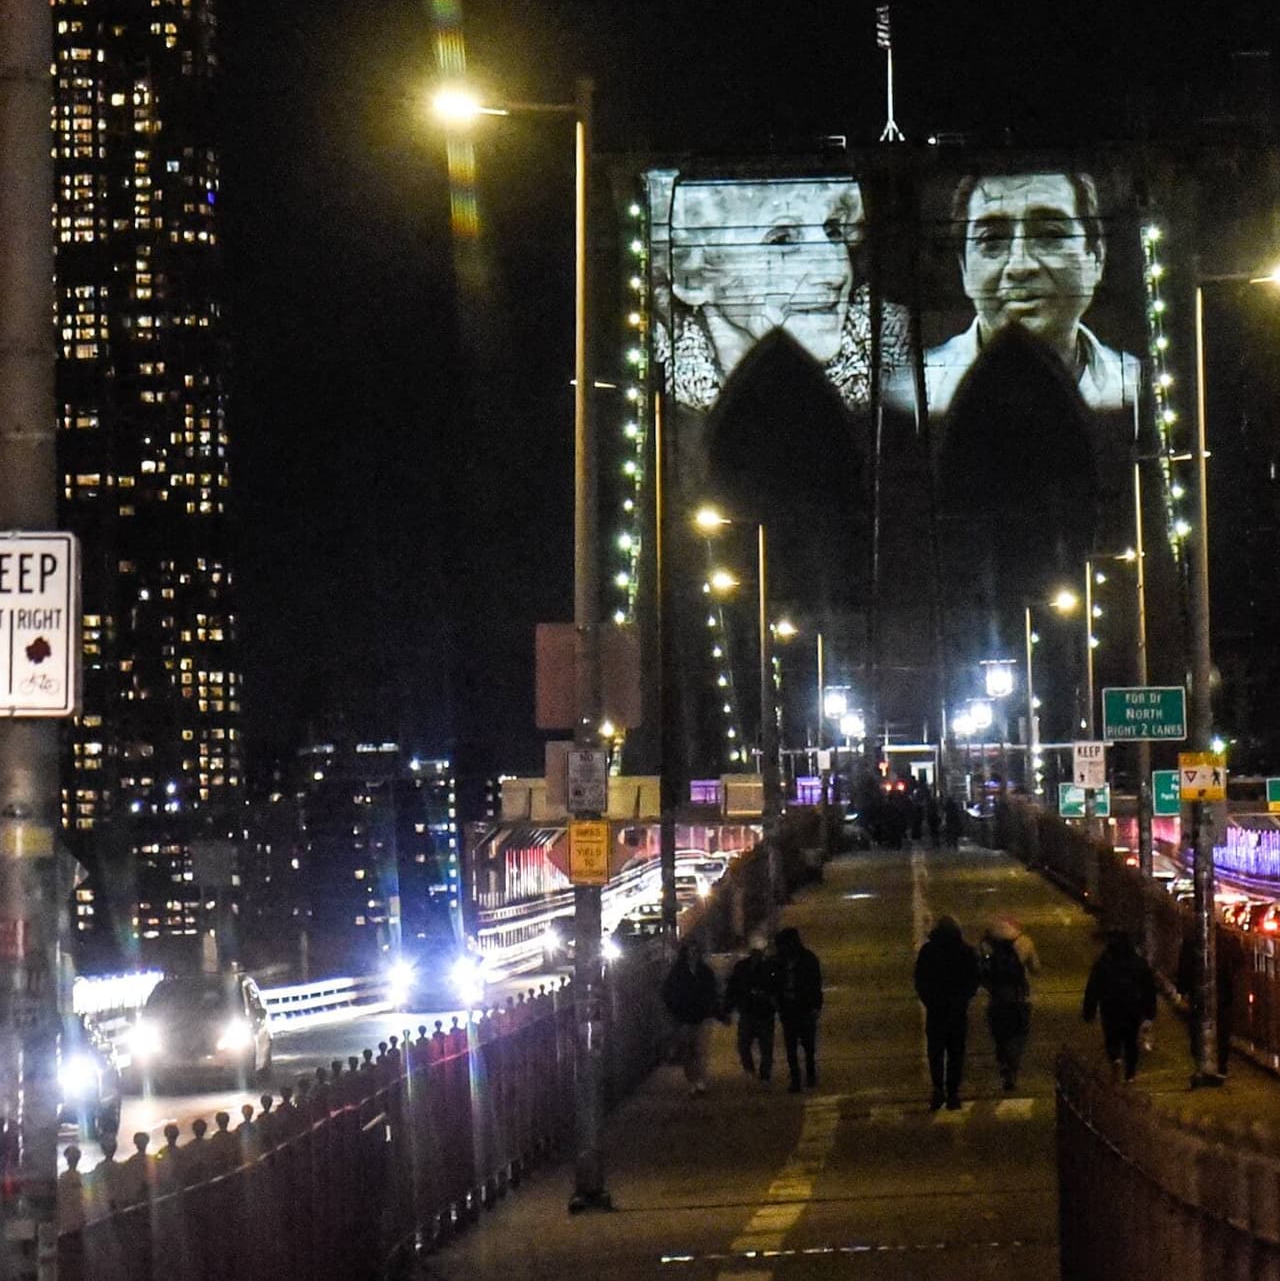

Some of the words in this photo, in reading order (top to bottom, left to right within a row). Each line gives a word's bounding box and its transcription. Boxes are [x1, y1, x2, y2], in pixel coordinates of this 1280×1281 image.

[17, 609, 62, 629] RIGHT
[1107, 725, 1136, 736] RIGHT
[1141, 722, 1148, 735] 2
[1152, 724, 1182, 735] LANES
[1078, 746, 1101, 757] KEEP
